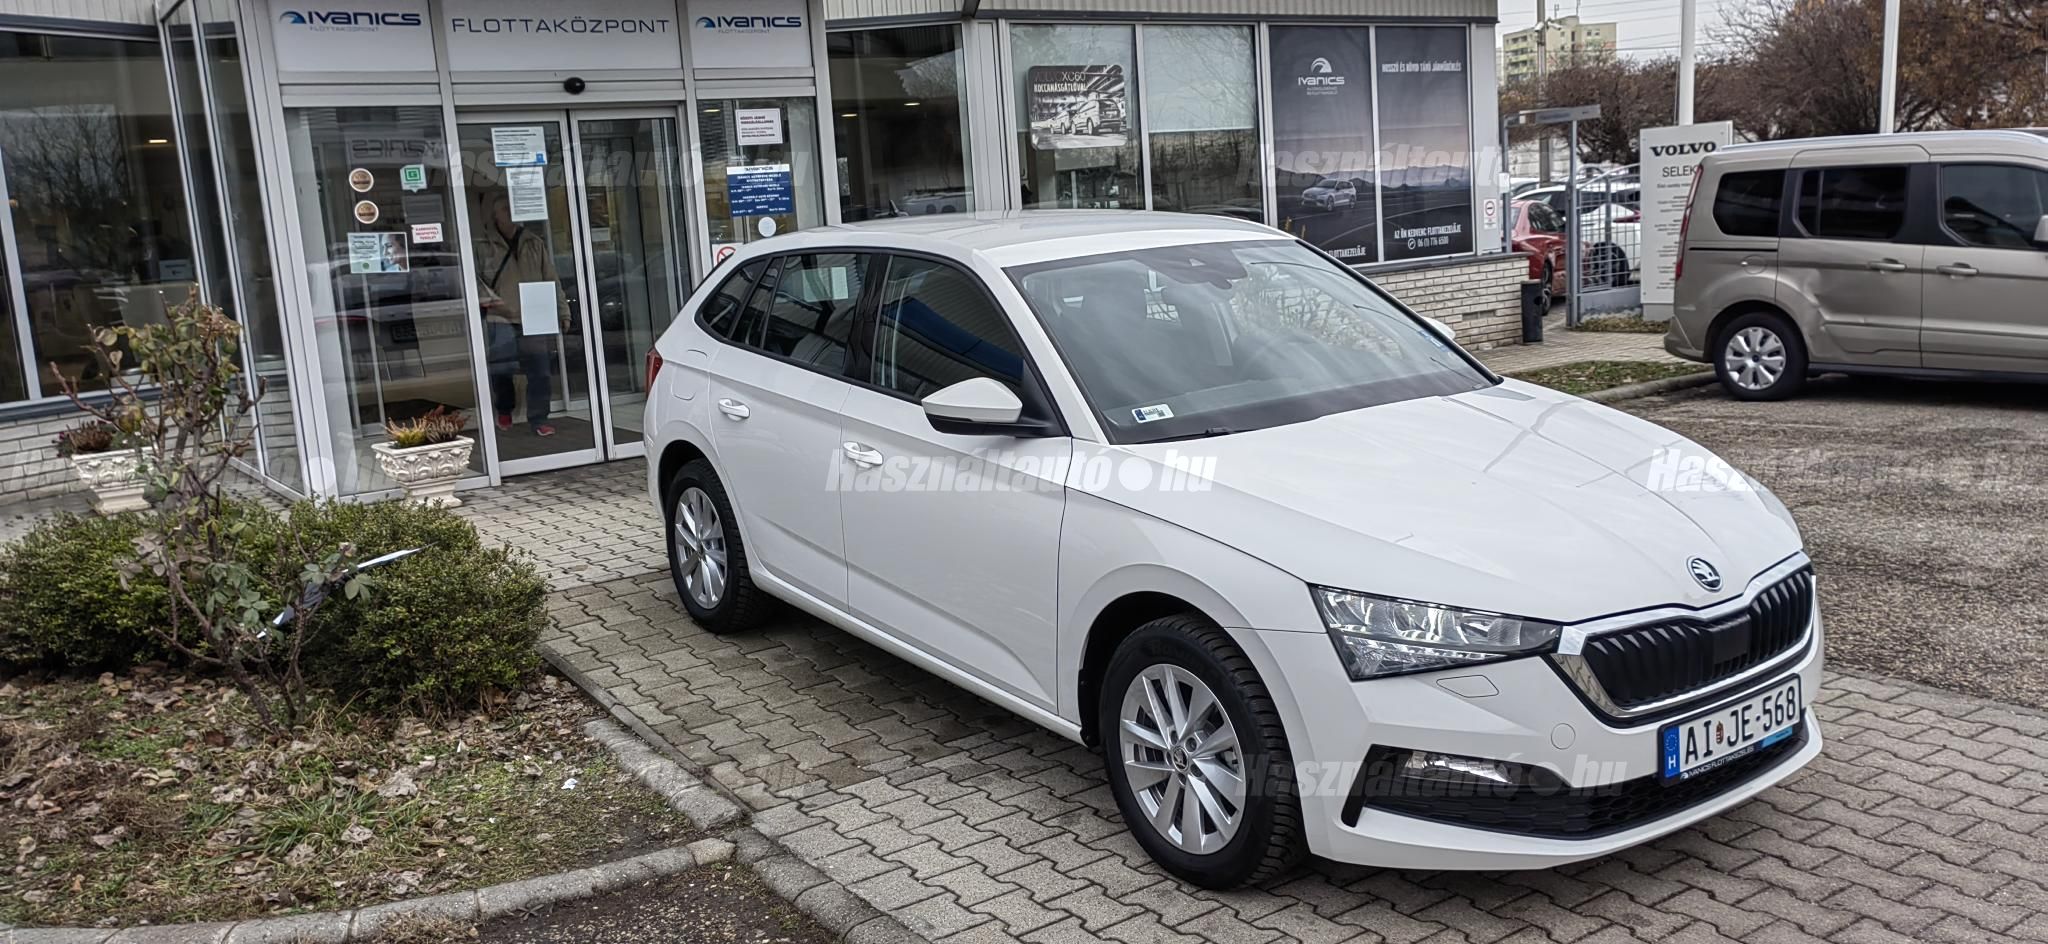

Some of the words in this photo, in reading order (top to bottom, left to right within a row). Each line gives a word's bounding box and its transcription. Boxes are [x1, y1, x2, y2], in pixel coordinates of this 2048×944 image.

[308, 11, 421, 26] IVANICS
[451, 16, 670, 33] FLOTTAKÖZPONT
[717, 16, 802, 28] IVANICS
[1062, 71, 1086, 81] XC60
[1298, 76, 1345, 86] IVANICS
[1650, 141, 1717, 157] VOLVO
[1662, 165, 1699, 178] SELEK
[1685, 720, 1714, 765] AI
[1668, 755, 1677, 770] H
